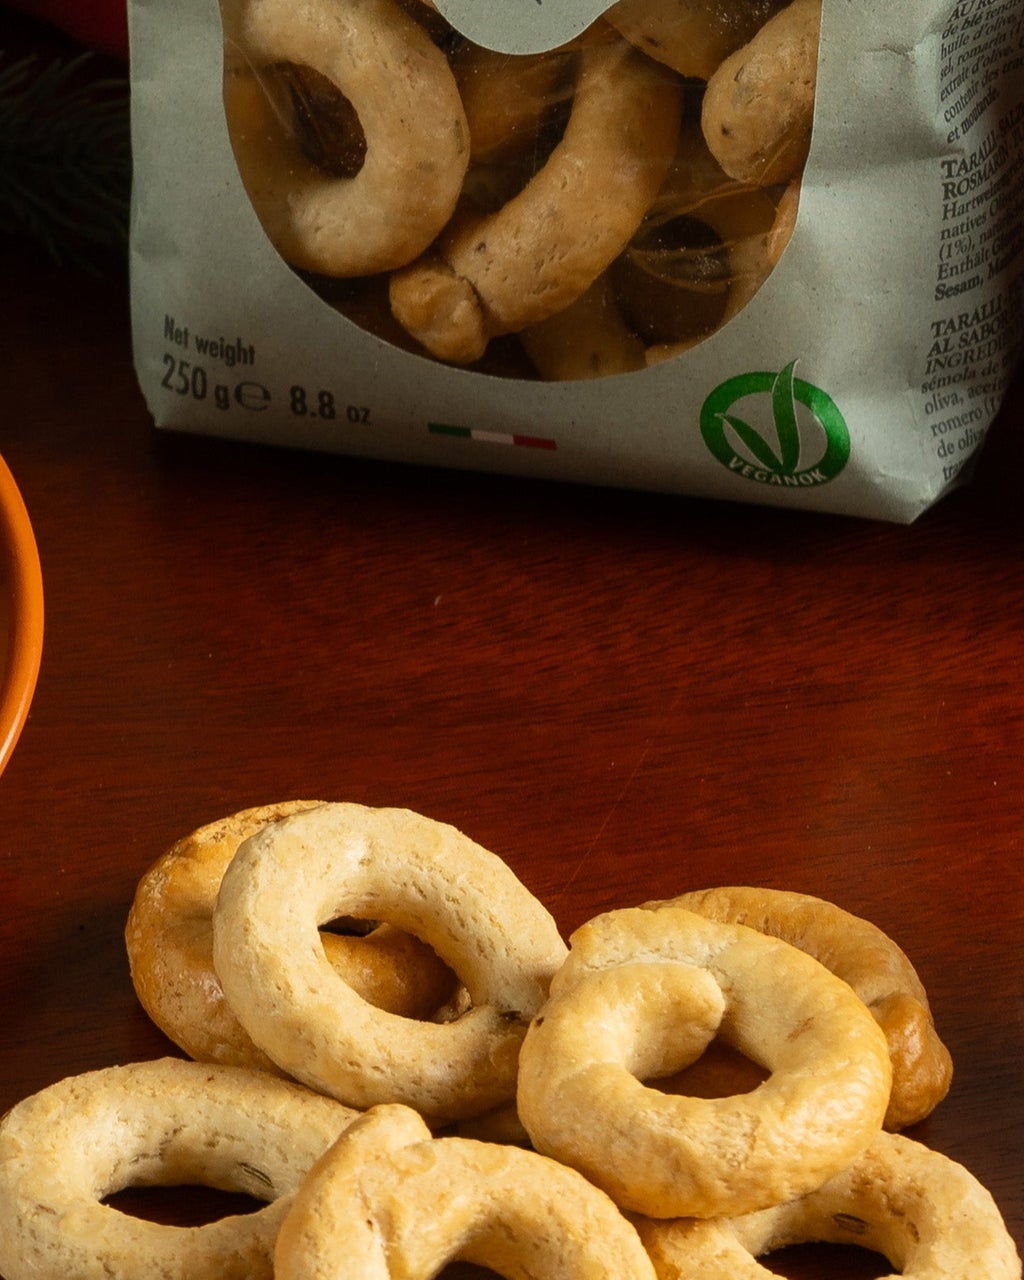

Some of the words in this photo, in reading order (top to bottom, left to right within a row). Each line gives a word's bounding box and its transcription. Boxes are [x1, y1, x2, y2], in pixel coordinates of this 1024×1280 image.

[946, 0, 977, 24] AU
[940, 31, 970, 63] huile
[946, 124, 961, 146] et
[940, 127, 999, 180] TARALLI
[163, 314, 189, 347] Net
[194, 333, 256, 367] weight
[926, 337, 955, 360] AL
[160, 353, 207, 401] 250
[289, 385, 337, 420] 8.8
[346, 405, 372, 425] oz
[924, 391, 964, 416] oliva,
[929, 405, 983, 438] romero
[936, 439, 955, 459] de
[728, 456, 828, 487] VEGANOK
